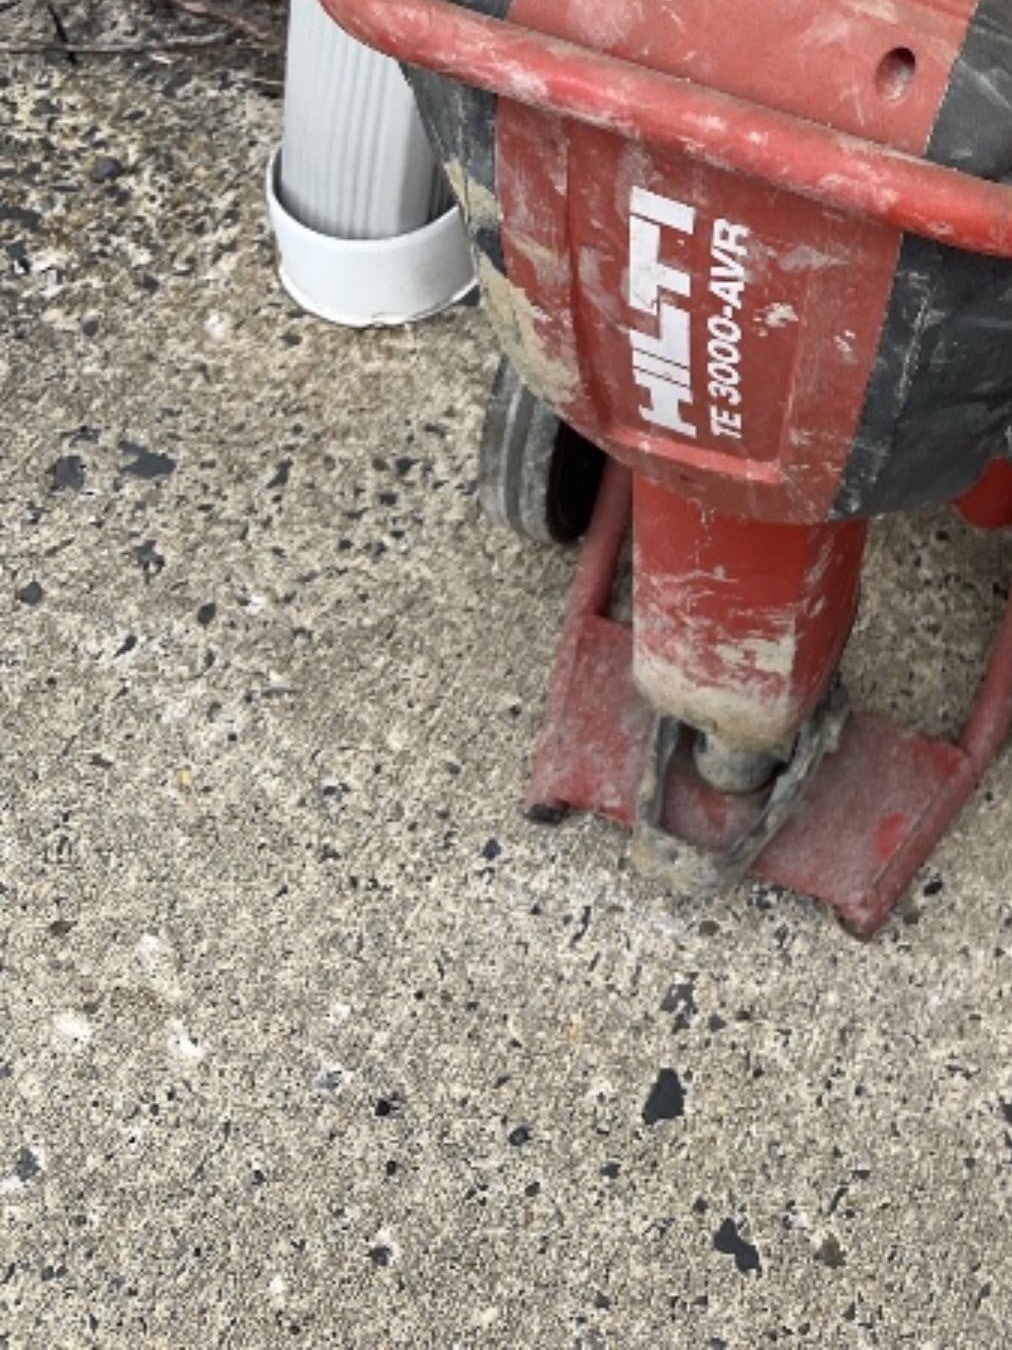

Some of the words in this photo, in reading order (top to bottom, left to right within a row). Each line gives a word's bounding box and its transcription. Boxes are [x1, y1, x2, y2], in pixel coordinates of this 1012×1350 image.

[628, 184, 698, 439] HILTI
[707, 218, 751, 405] 3000-AVR
[709, 405, 743, 439] TE
